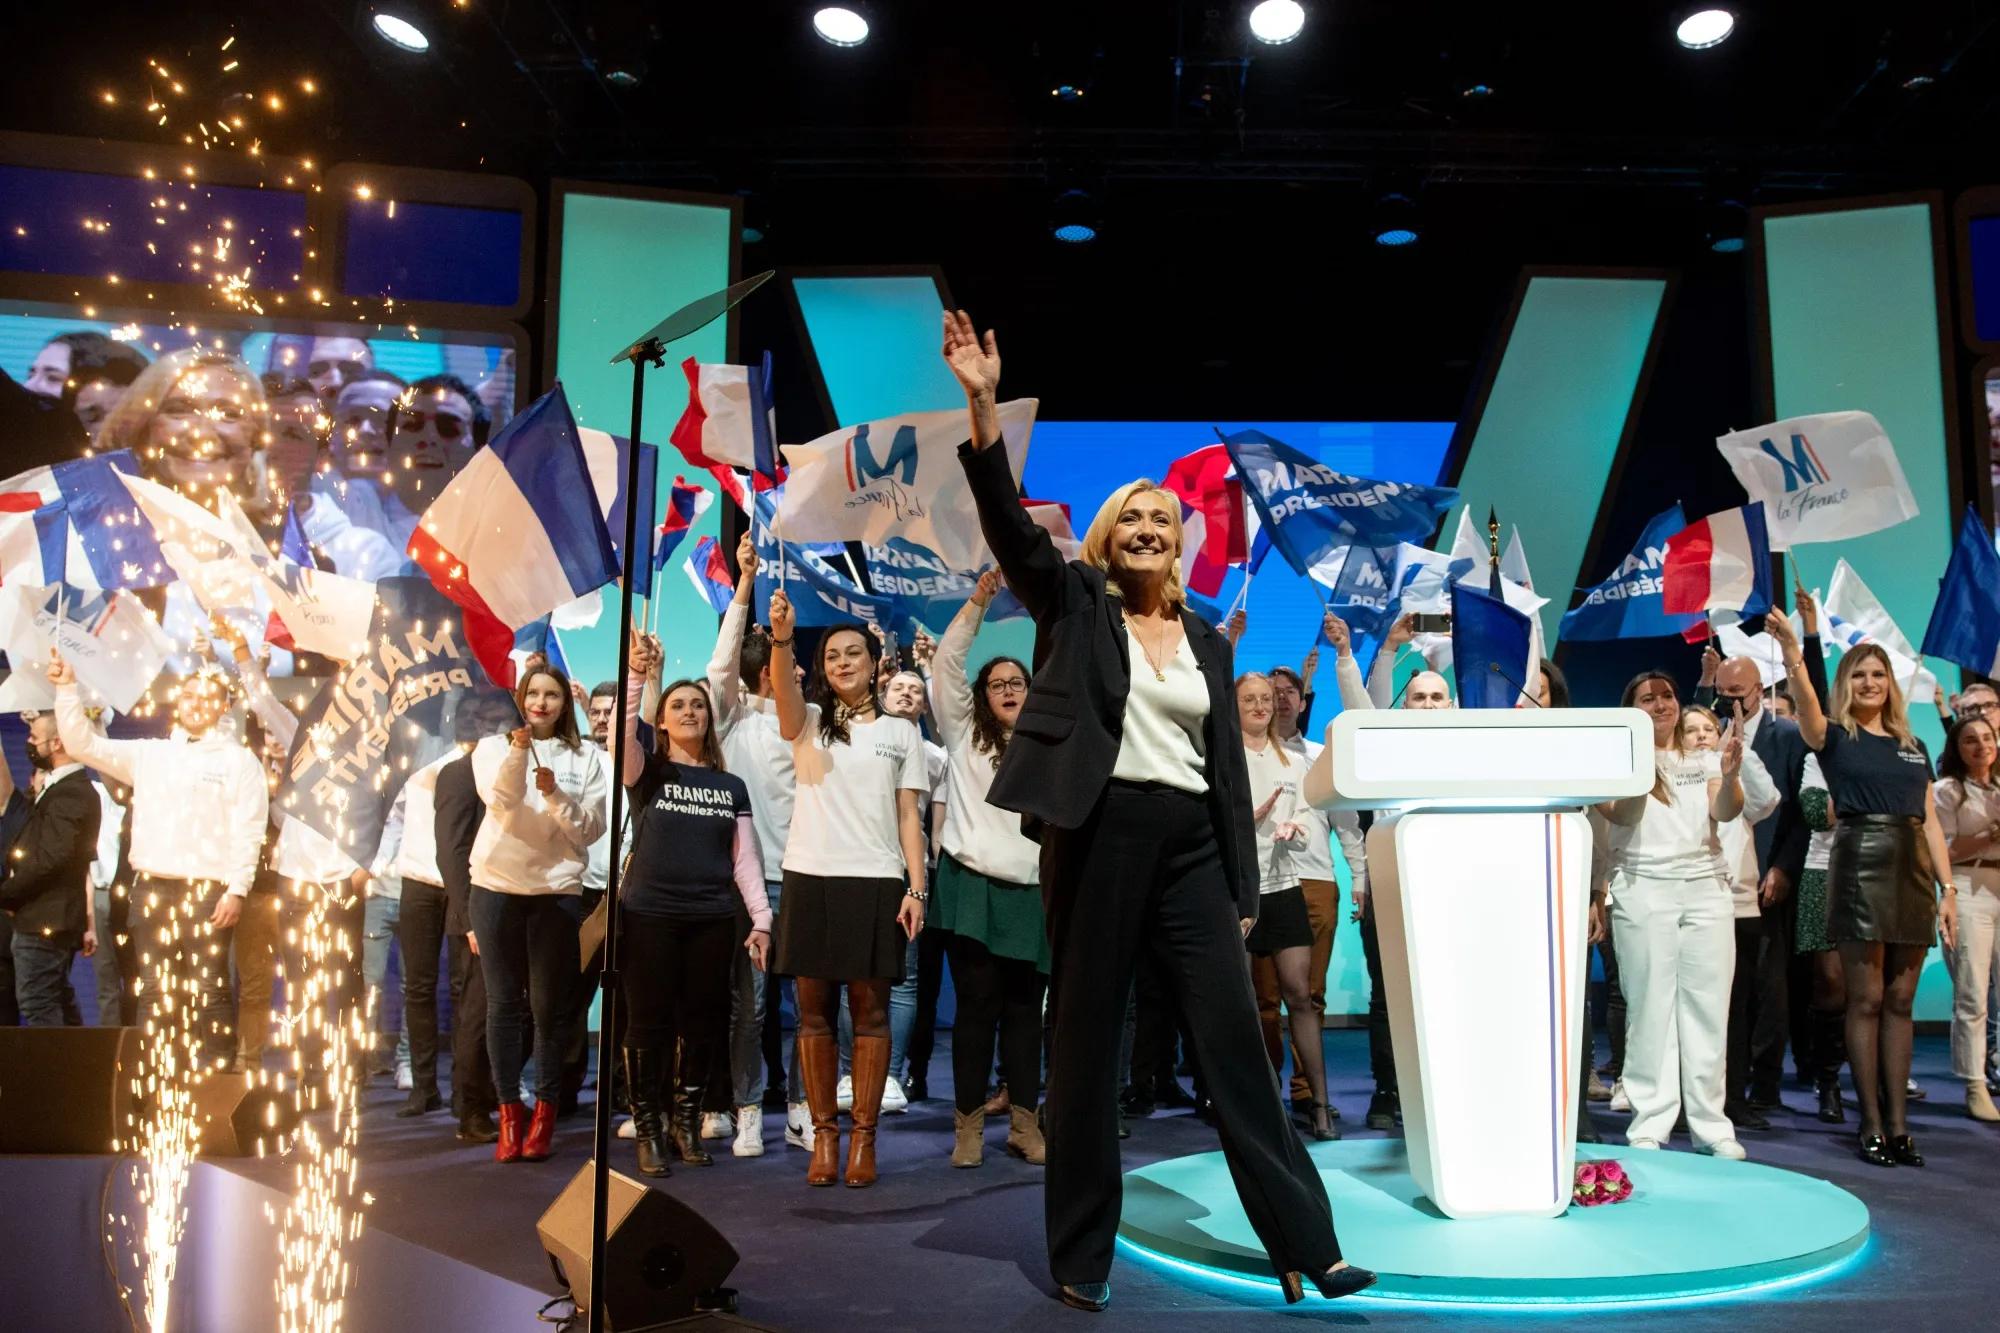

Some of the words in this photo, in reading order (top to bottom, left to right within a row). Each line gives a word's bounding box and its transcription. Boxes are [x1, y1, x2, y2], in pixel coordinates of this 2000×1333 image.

[1760, 433, 1828, 493] M
[1791, 483, 1849, 522] France
[663, 783, 734, 806] FRANÇAIS
